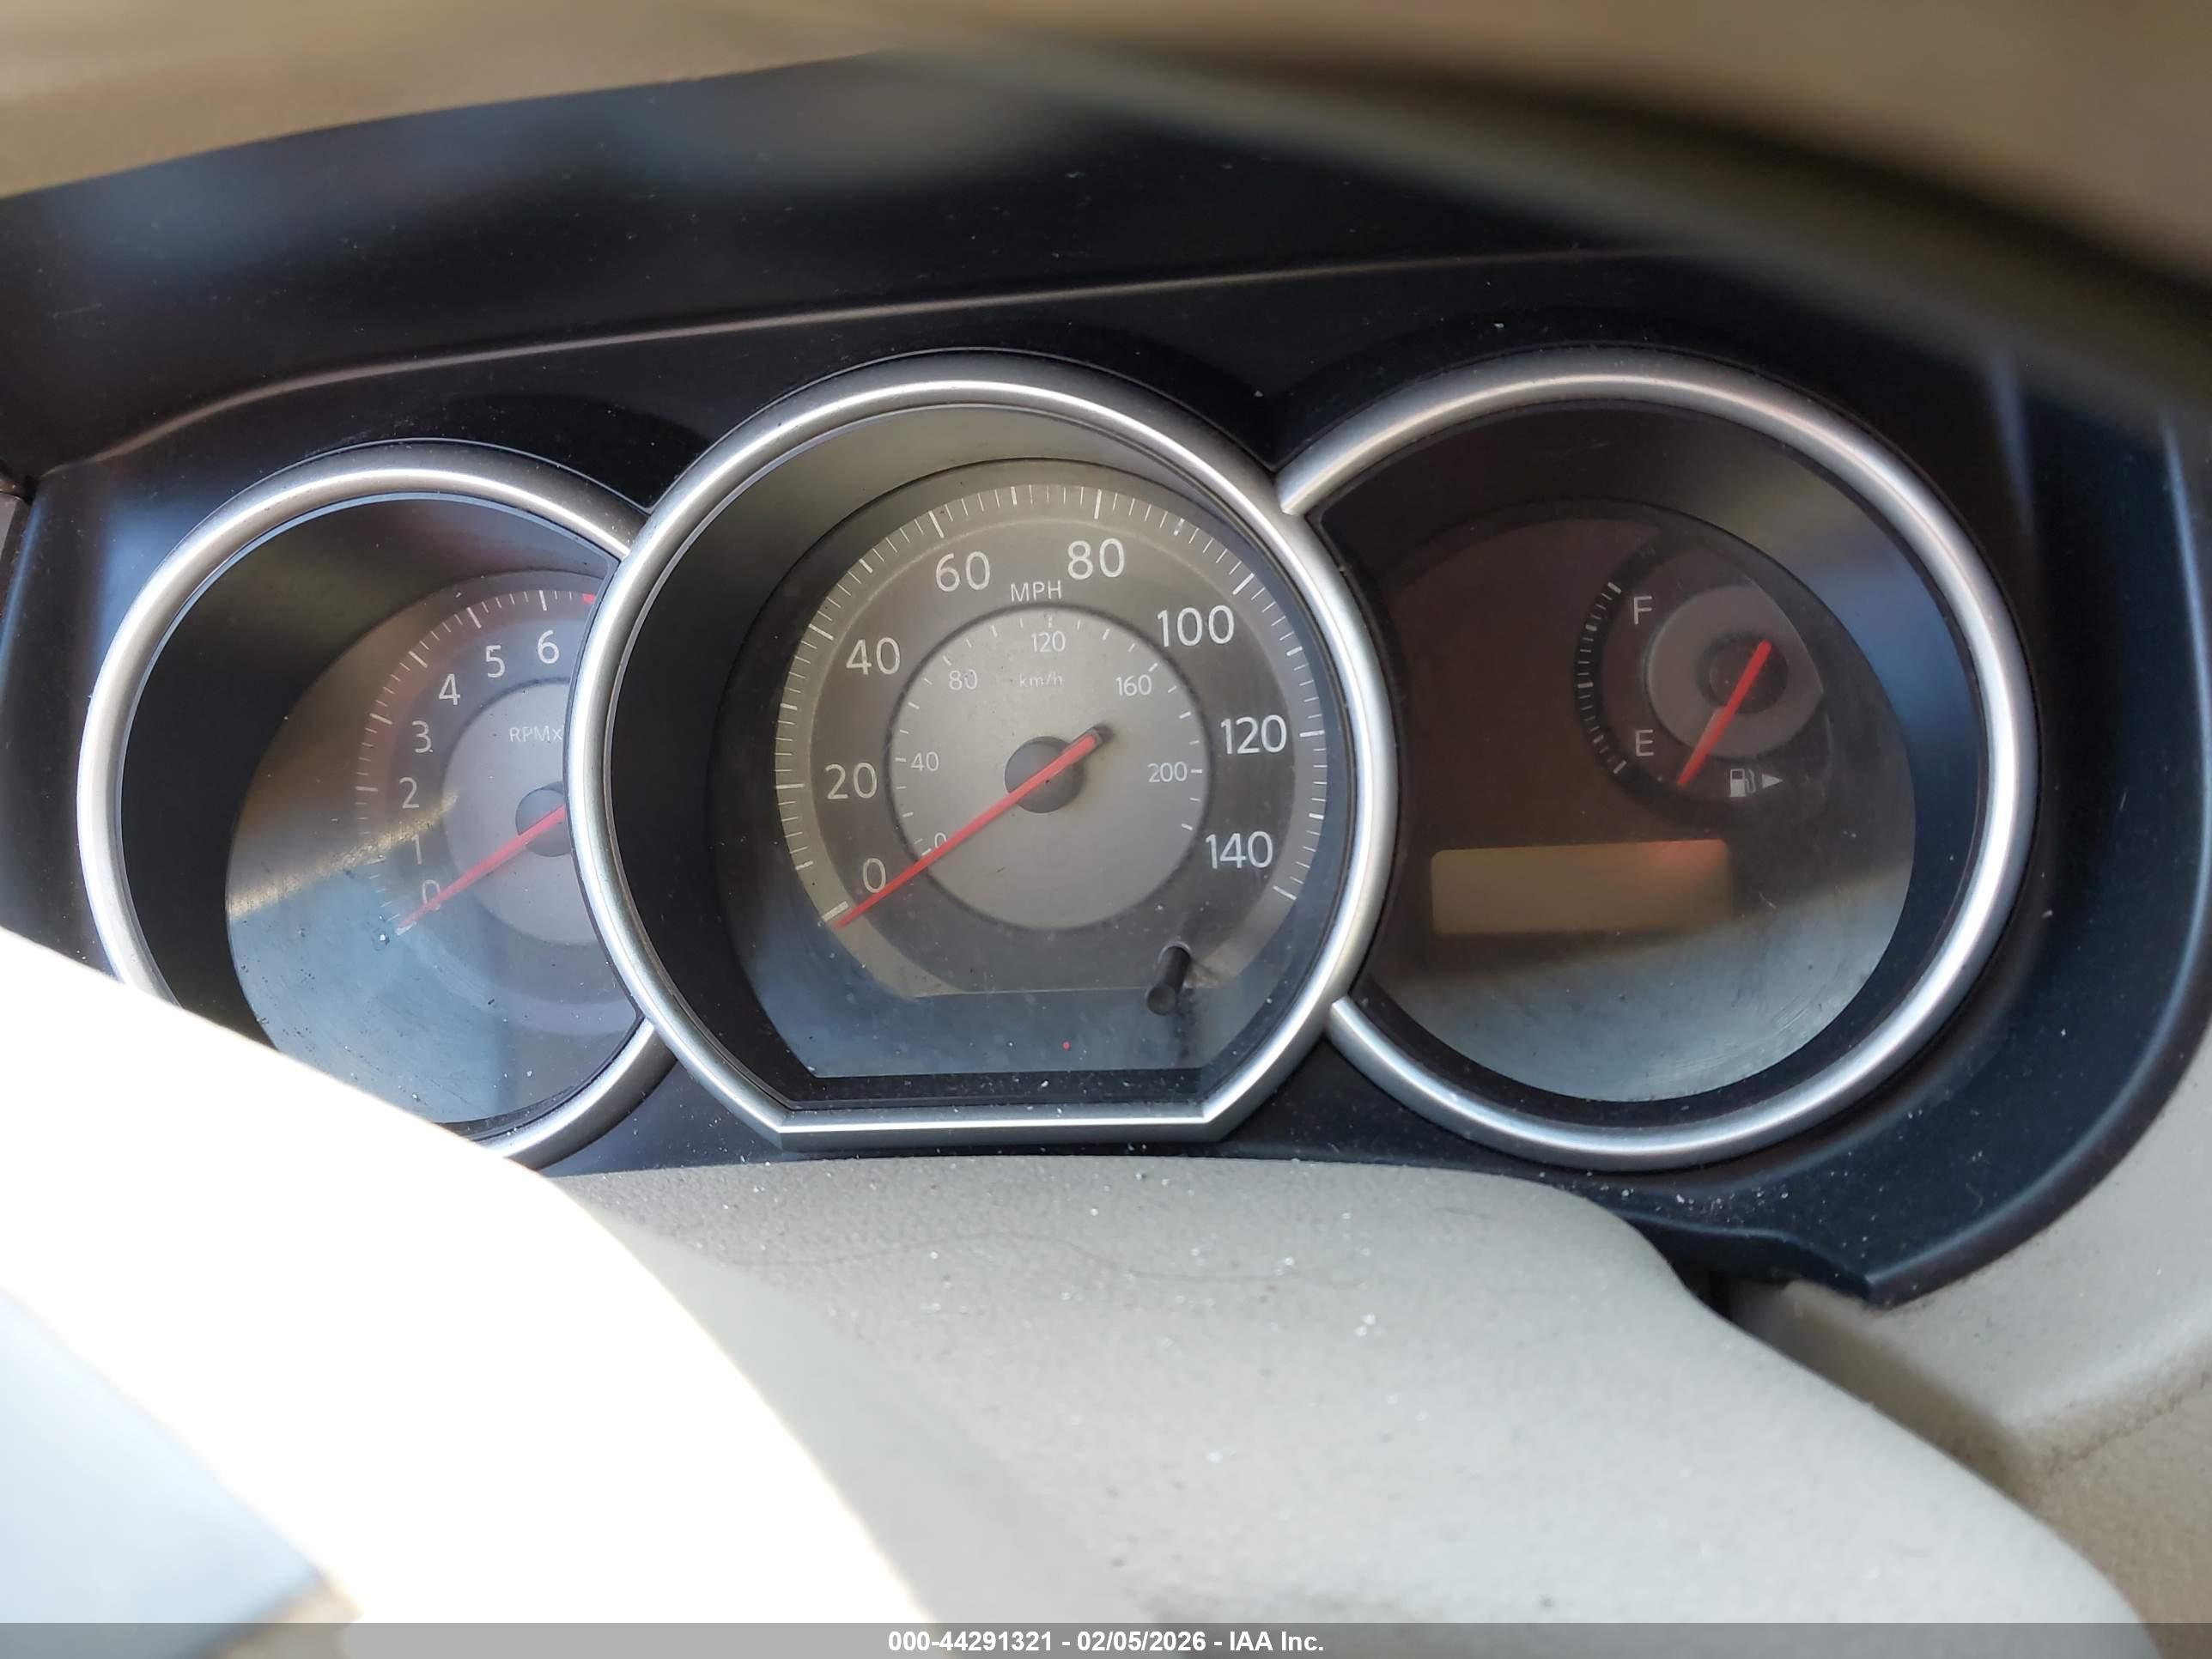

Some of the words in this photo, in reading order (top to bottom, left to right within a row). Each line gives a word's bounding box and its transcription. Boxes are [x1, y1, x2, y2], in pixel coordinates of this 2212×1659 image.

[936, 551, 990, 592] 60
[1067, 538, 1125, 580] 80
[1011, 580, 1061, 602] MPH
[1158, 605, 1236, 647] 100
[1633, 595, 1653, 625] F
[537, 629, 561, 665] 6
[846, 637, 901, 675] 40
[1031, 630, 1066, 653] 120
[485, 645, 506, 678] 5
[438, 673, 461, 705] 4
[949, 669, 978, 690] 80
[1019, 672, 1063, 687] km/h
[1115, 674, 1152, 696] 160
[411, 720, 433, 753] 3
[509, 726, 565, 742] RPMx
[1220, 714, 1287, 755] 120
[1635, 729, 1655, 757] E
[910, 751, 939, 772] 40
[1148, 762, 1188, 782] 200
[399, 777, 420, 808] 2
[825, 763, 878, 799] 20
[411, 834, 422, 865] 1
[1205, 831, 1273, 870] 140
[862, 858, 886, 894] 0
[422, 879, 441, 911] 0
